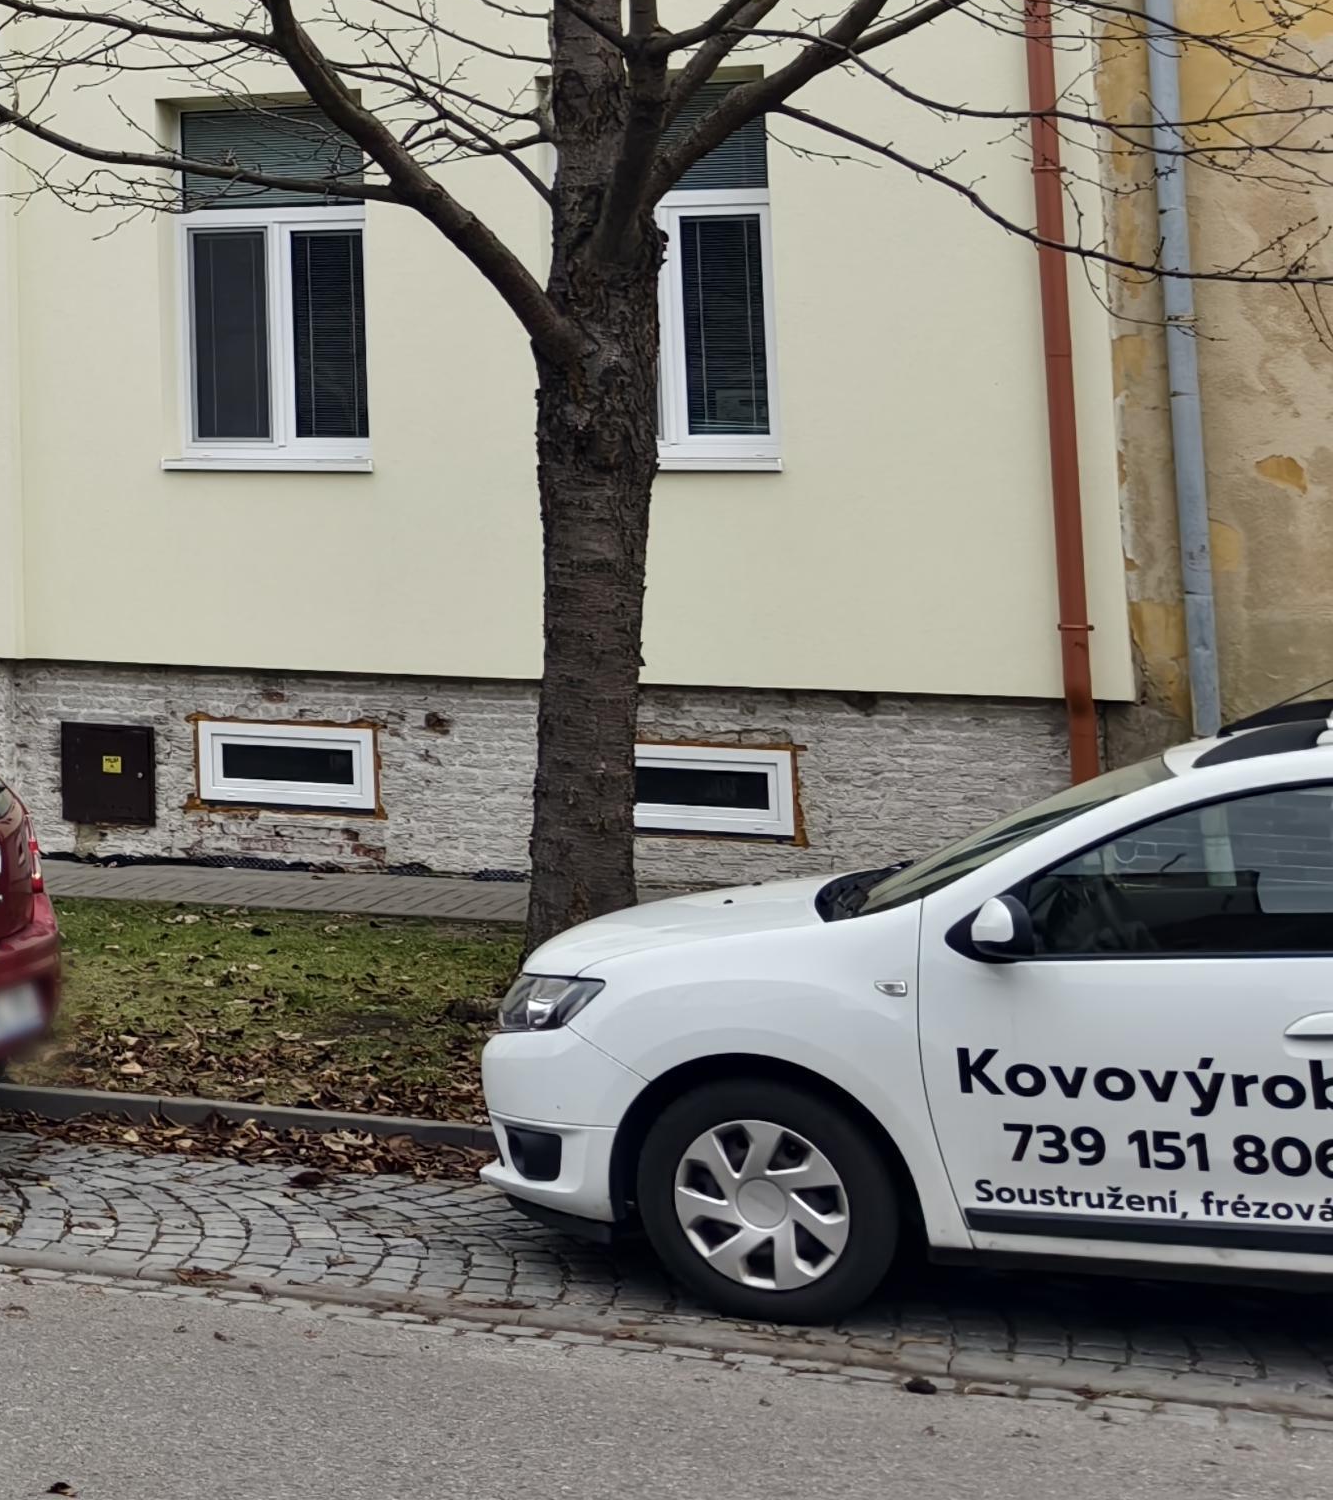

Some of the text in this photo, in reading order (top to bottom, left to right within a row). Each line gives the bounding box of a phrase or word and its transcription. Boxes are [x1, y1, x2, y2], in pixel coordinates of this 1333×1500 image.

[1003, 1122, 1106, 1167] 739
[1127, 1129, 1210, 1172] 151
[974, 1179, 1189, 1220] Soustružení,
